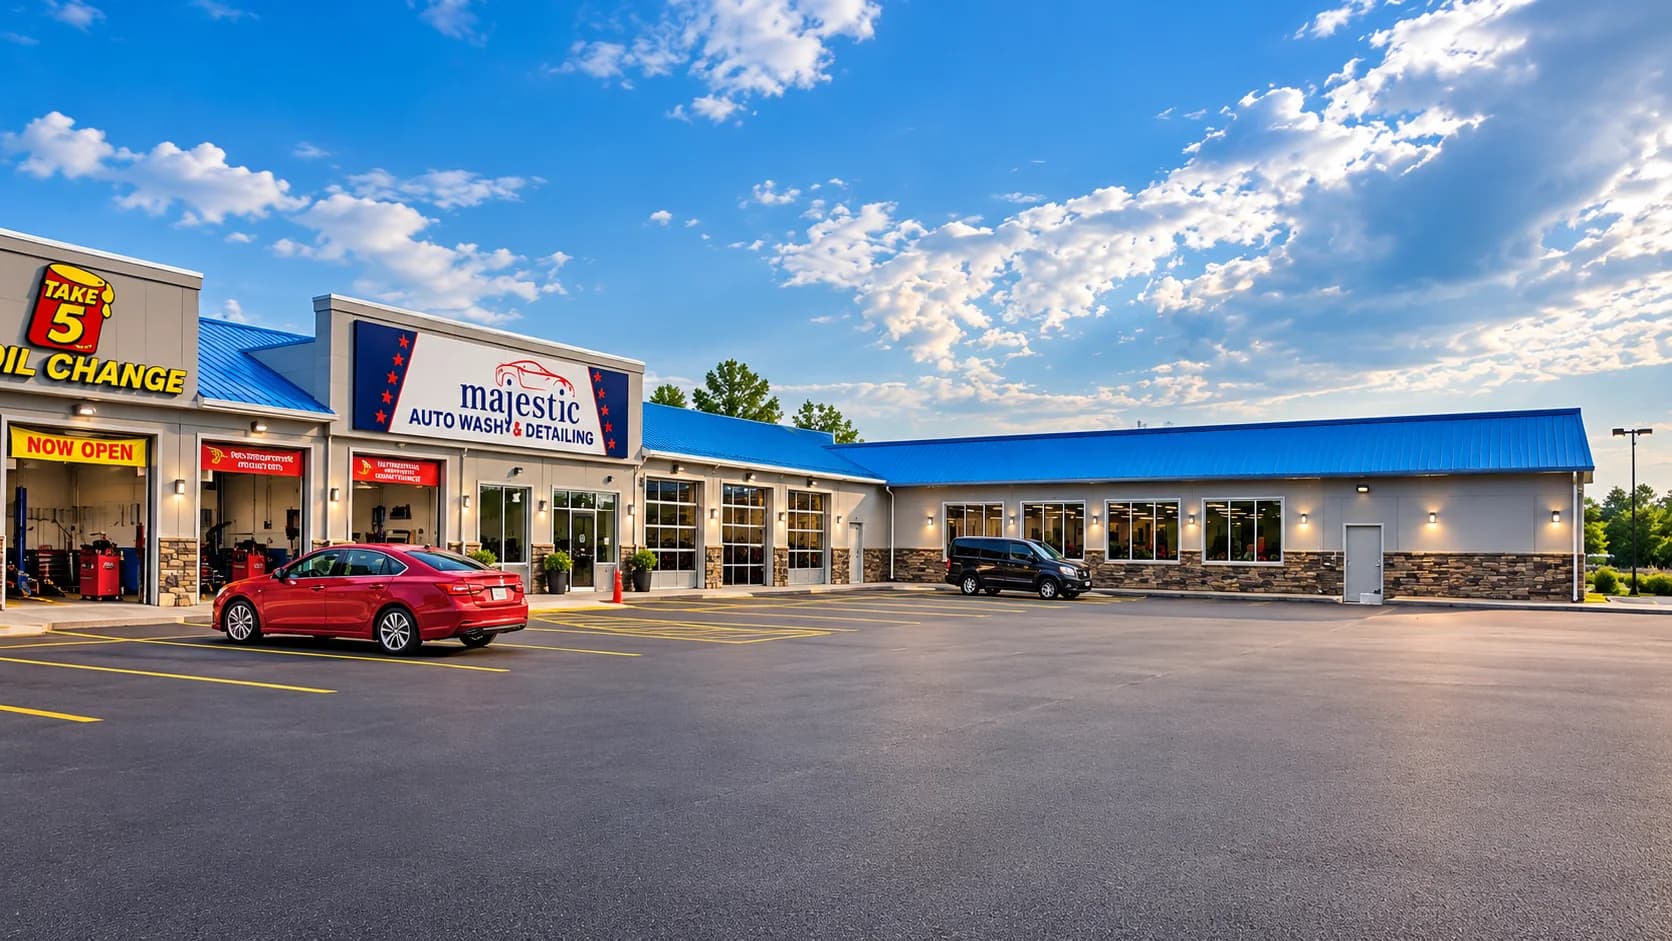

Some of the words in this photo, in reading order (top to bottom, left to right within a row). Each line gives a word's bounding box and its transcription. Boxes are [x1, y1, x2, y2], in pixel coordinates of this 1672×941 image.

[45, 279, 99, 305] TAKE
[47, 303, 86, 344] 5
[0, 344, 37, 377] IL
[46, 352, 188, 394] CHANGE
[460, 378, 580, 433] majestic
[409, 408, 455, 429] AUTO
[459, 414, 504, 435] WASH
[513, 421, 522, 437] &
[526, 423, 594, 446] DETAILING
[27, 436, 74, 457] NOW
[81, 439, 133, 460] OPEN
